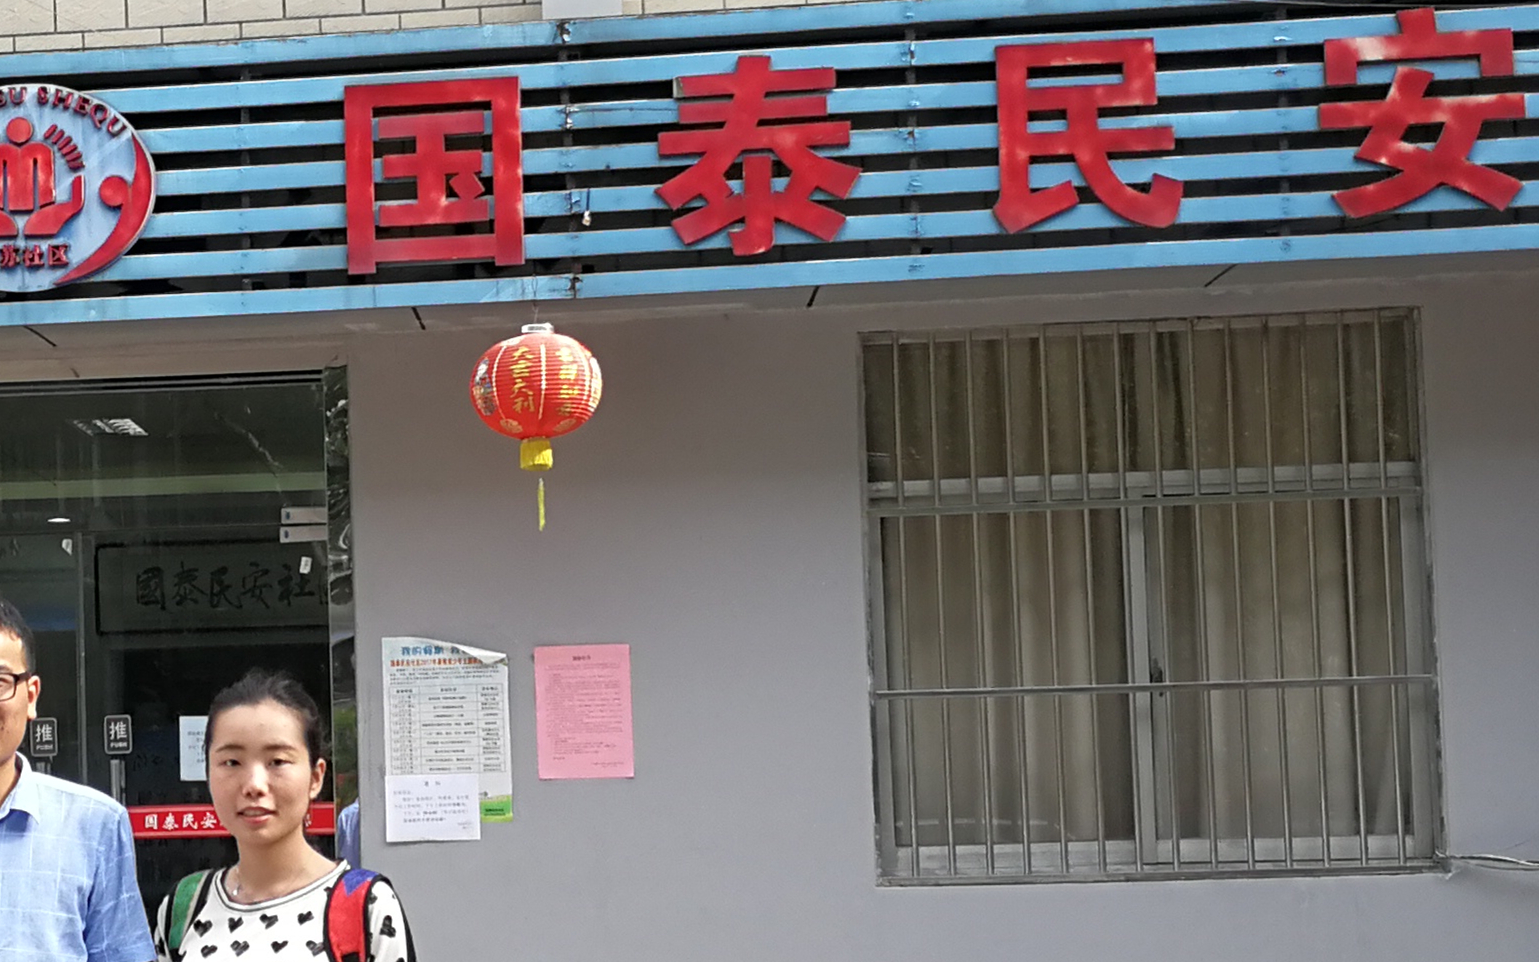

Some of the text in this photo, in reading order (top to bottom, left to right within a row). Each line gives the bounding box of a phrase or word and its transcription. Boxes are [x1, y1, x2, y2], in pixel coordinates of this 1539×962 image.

[36, 86, 128, 136] SHEQU
[344, 6, 1524, 276] 国泰民安
[36, 723, 54, 743] 推
[109, 721, 128, 740] 推
